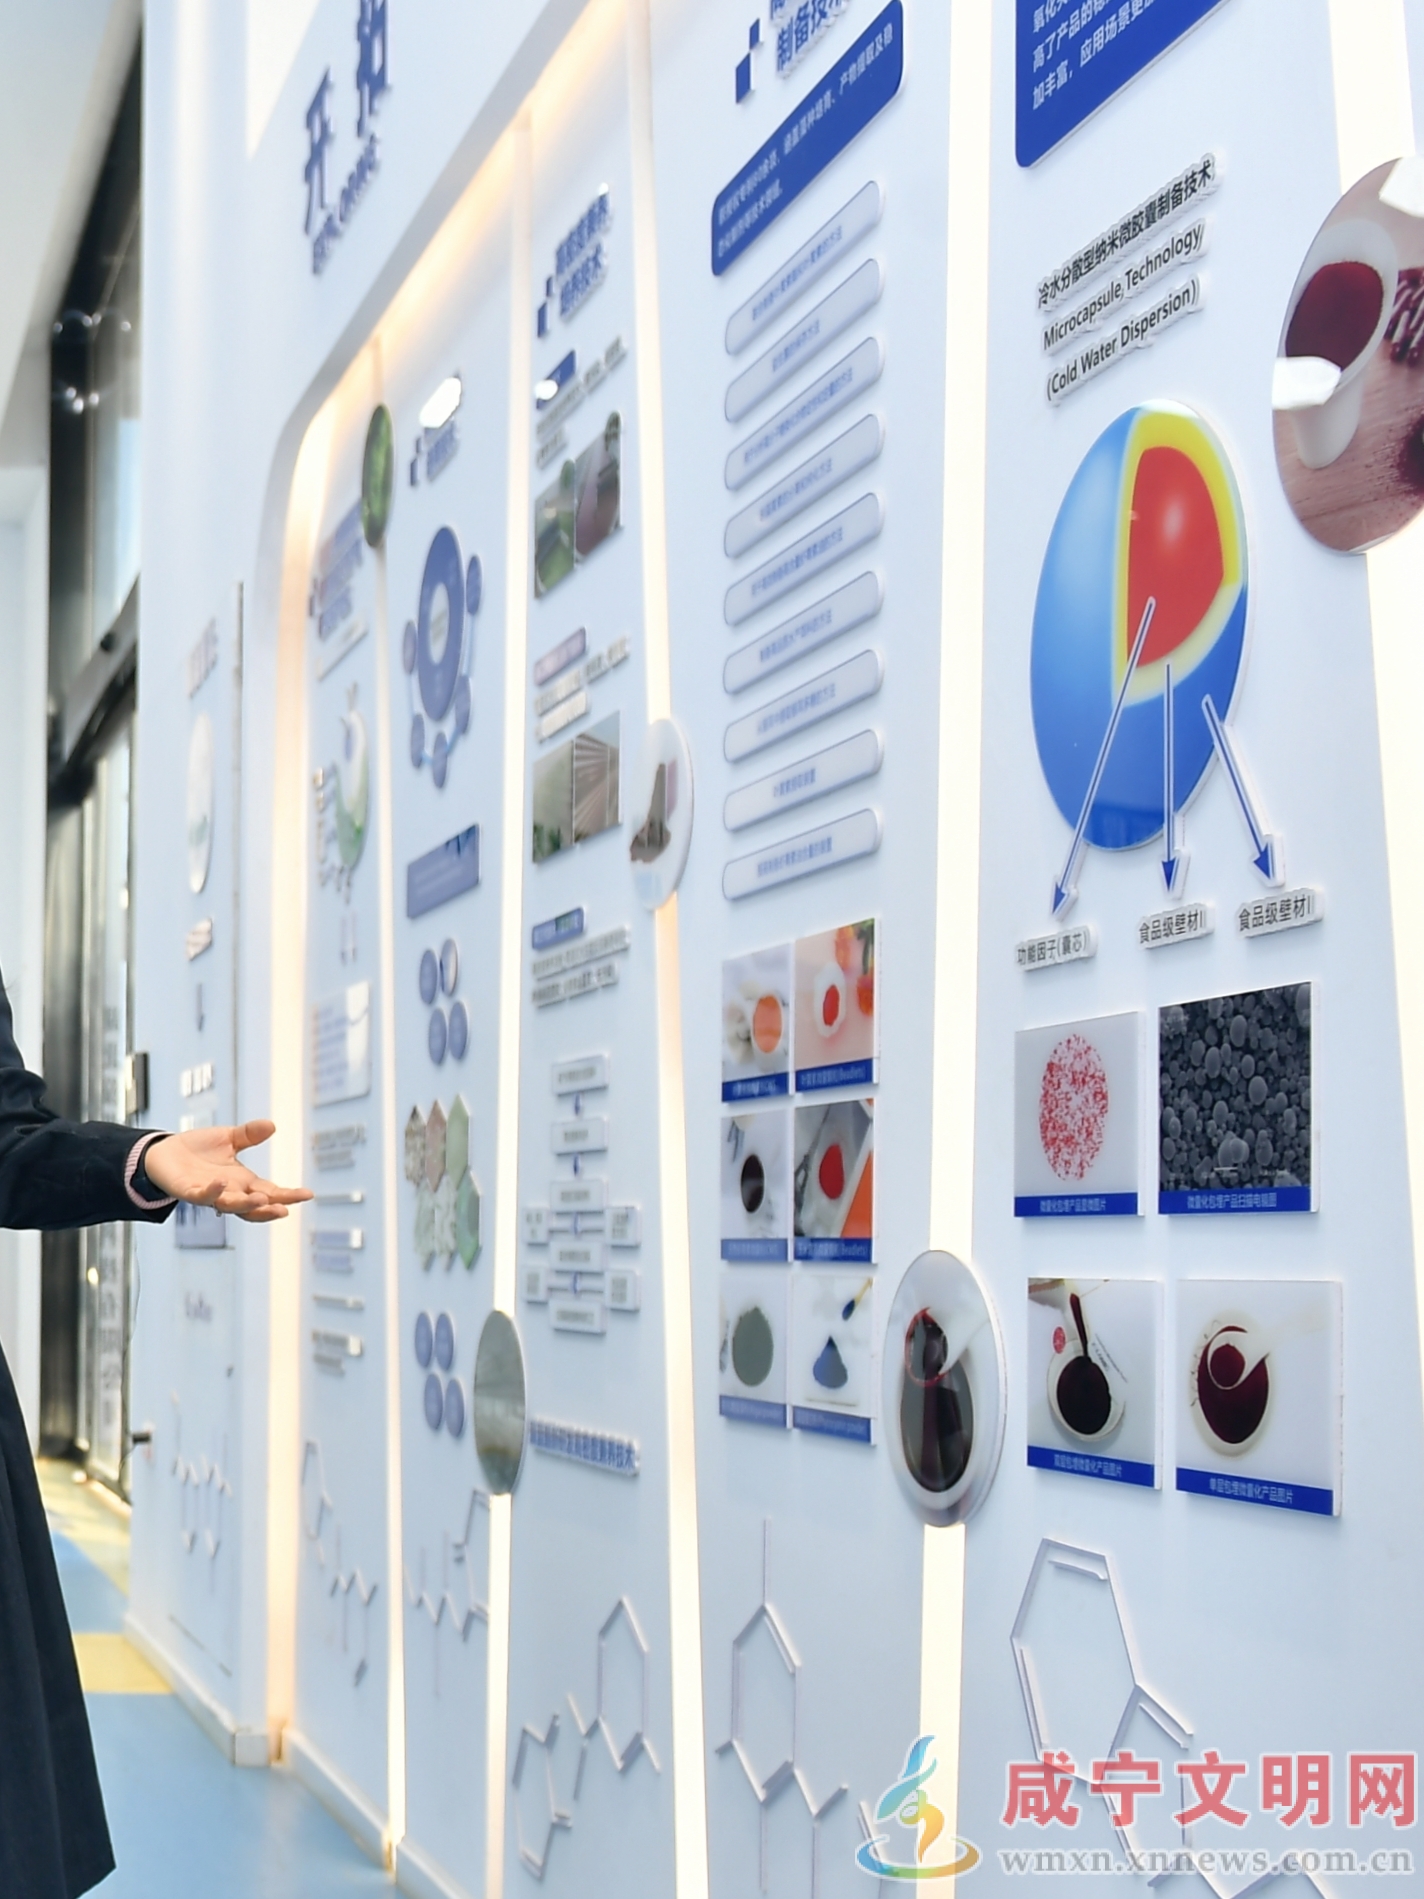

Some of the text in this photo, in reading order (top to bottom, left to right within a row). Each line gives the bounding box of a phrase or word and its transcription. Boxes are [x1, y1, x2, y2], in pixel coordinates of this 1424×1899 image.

[777, 0, 841, 71] 制备技
[1033, 0, 1109, 72] 高了产品的
[1033, 0, 1154, 110] 加丰富，应用场景更
[1037, 159, 1212, 309] 冷水分散型纳米微胶囊制备技术
[1125, 229, 1201, 290] Technology
[1081, 339, 1117, 374] Water
[1121, 280, 1196, 347] Dispersion)
